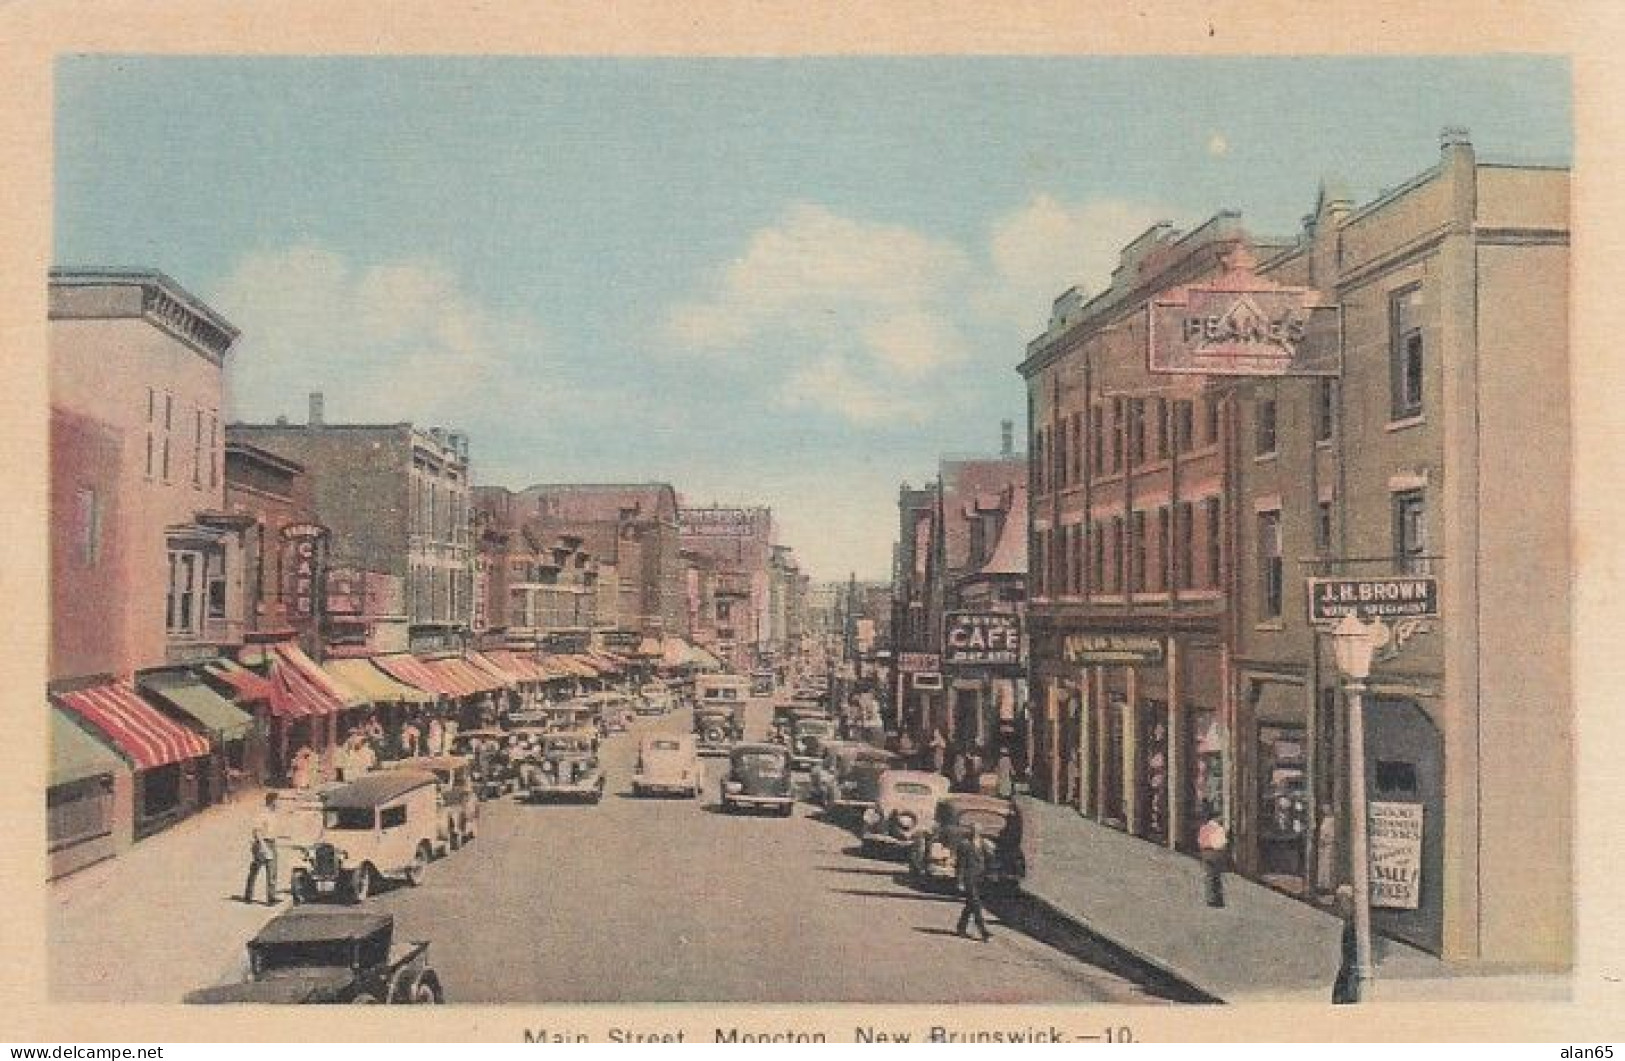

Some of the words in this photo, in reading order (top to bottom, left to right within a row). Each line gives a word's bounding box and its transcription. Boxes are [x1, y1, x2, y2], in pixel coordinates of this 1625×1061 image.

[1359, 581, 1427, 601] BROWN
[949, 627, 1018, 649] CAFE
[523, 1028, 590, 1043] Main
[714, 1027, 827, 1043] Moncton
[855, 1027, 912, 1043] New
